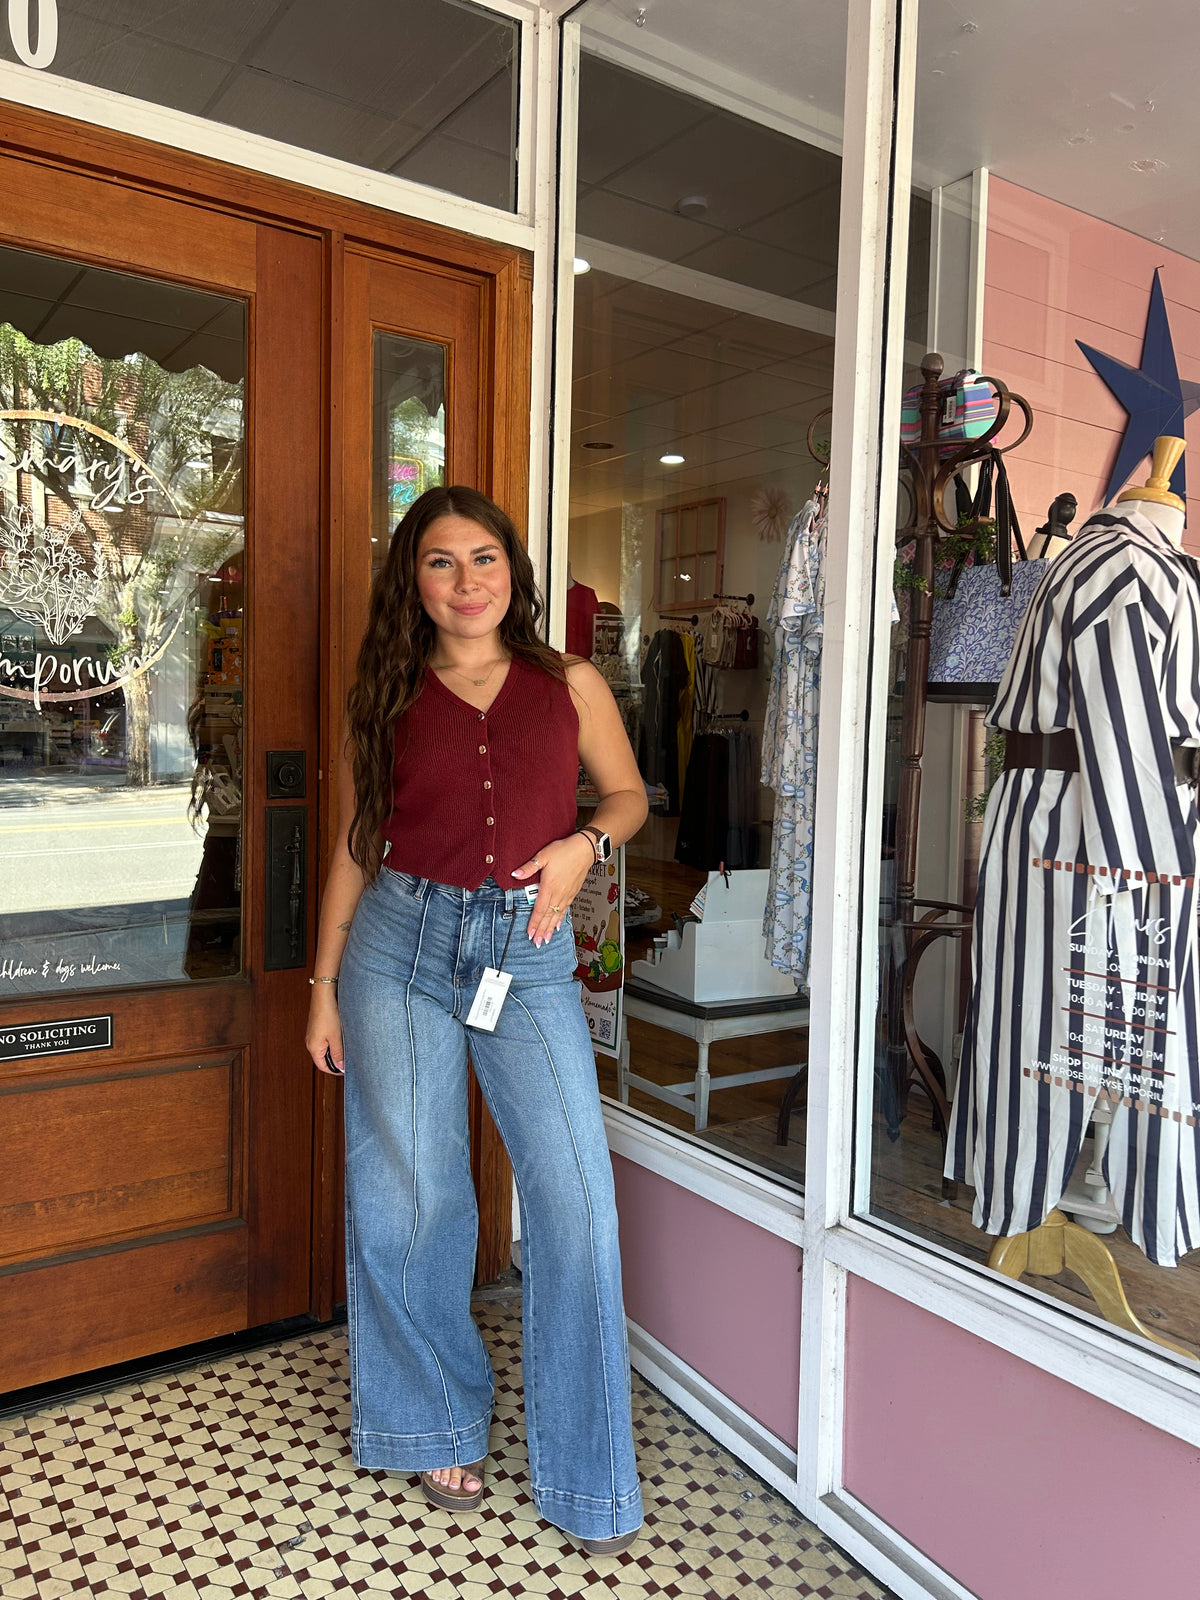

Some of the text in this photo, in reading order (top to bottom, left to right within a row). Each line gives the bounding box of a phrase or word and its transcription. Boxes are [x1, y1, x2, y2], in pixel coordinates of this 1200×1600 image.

[1069, 943, 1114, 958] SUNDY
[1123, 950, 1171, 969] ONDAY
[0, 960, 38, 979] hildren
[42, 960, 50, 978] &
[56, 958, 76, 983] dogs
[1097, 961, 1140, 976] CLOD
[1066, 977, 1115, 995] TUESDAY
[1124, 989, 1165, 1005] IDAY
[1067, 993, 1094, 1006] 10:00
[1095, 1000, 1113, 1011] AM
[1122, 1004, 1145, 1017] 600
[1148, 1009, 1165, 1021] PM
[20, 1025, 96, 1043] SOLICITING
[25, 1039, 70, 1050] THANK YOU
[1085, 1023, 1144, 1044] SATURDAY
[1093, 1040, 1111, 1051] AM
[1145, 1050, 1163, 1062] PM
[1052, 1052, 1168, 1090] SHOP ONLINE ANYTIM
